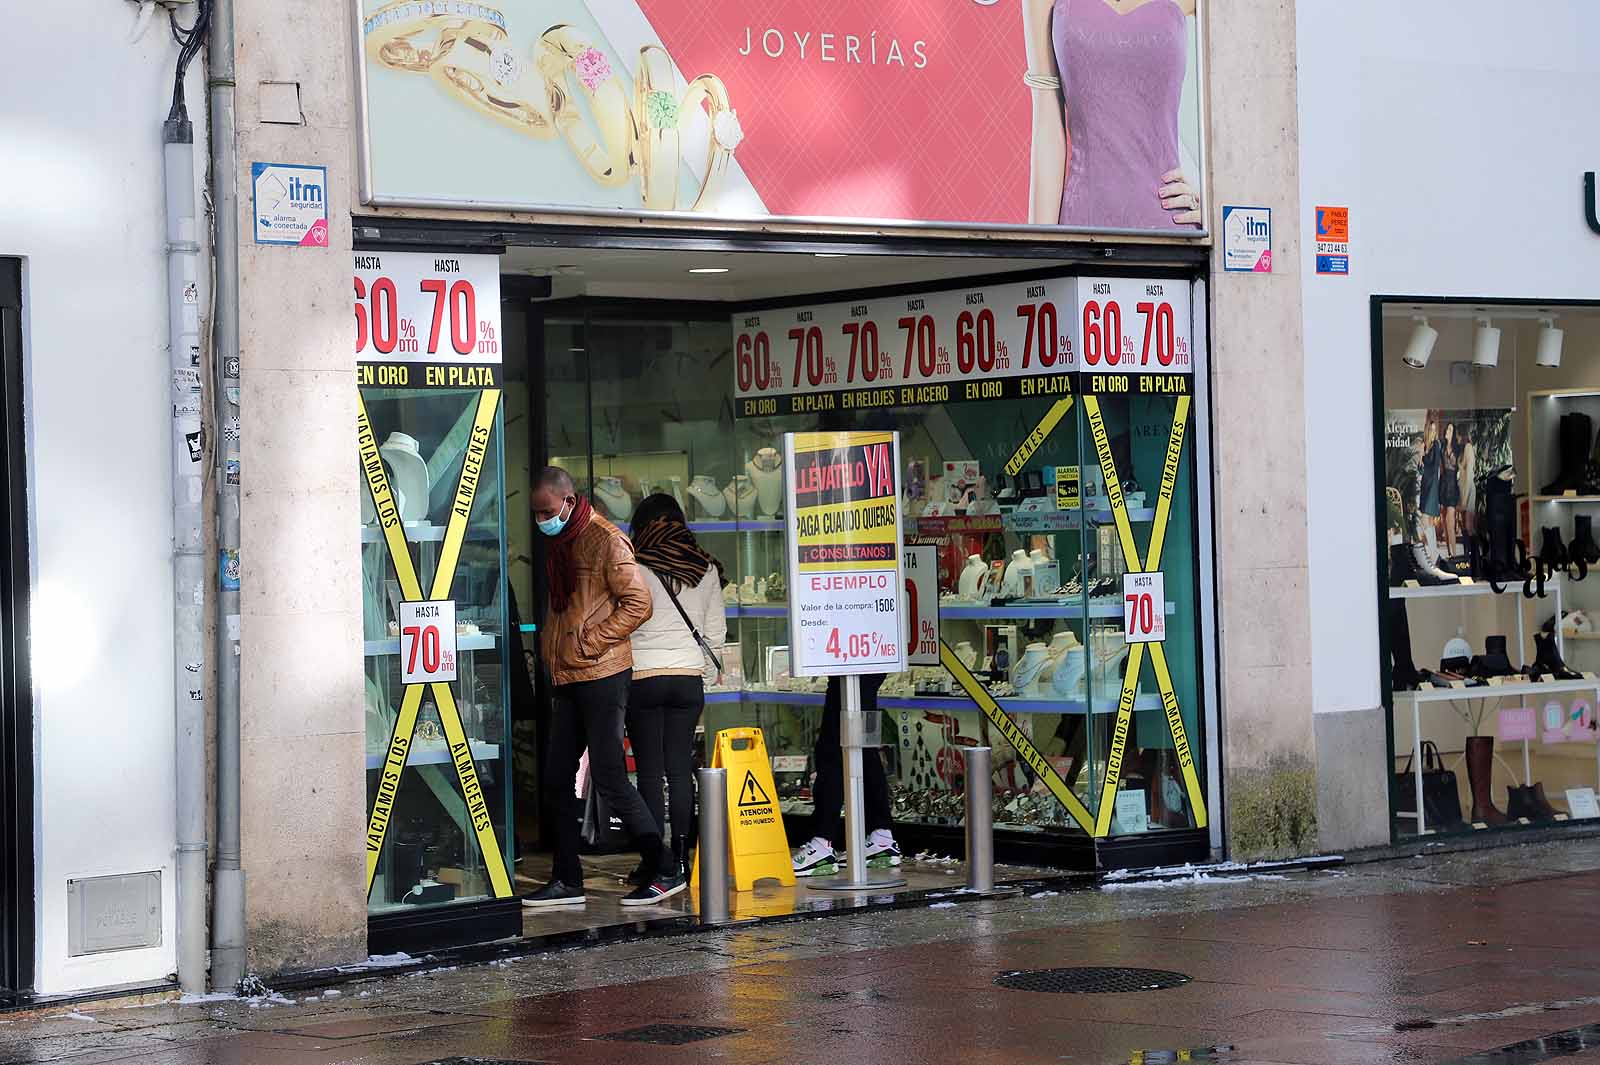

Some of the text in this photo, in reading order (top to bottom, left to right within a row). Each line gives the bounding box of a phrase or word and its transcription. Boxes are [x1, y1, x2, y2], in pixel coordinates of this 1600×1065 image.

[738, 27, 928, 69] JOYERÍAS
[289, 176, 322, 201] itm
[290, 202, 323, 210] seguridad
[273, 214, 297, 222] alarma
[1246, 216, 1268, 236] itm
[354, 256, 381, 270] HASTA
[434, 259, 460, 273] HASTA
[1026, 286, 1046, 298] HASTA
[1092, 283, 1111, 295] HASTA
[1146, 285, 1164, 296] HASTA
[907, 299, 925, 312] HASTA
[965, 292, 984, 305] HASTA
[797, 311, 813, 322] HASTA
[851, 305, 868, 317] HASTA
[744, 317, 760, 328] HASTA
[400, 338, 418, 353] DTO
[478, 340, 497, 354] DTO
[995, 357, 1010, 370] DTO
[1058, 352, 1074, 364] DTO
[1122, 353, 1136, 365] DTO
[1175, 353, 1188, 365] DTO
[357, 365, 409, 385] EN ORO
[425, 366, 494, 386] EN PLATA
[937, 363, 950, 375] DTO
[965, 381, 1003, 399] EN ORO
[1021, 375, 1071, 395] EN PLATA
[1092, 375, 1129, 393] EN ORO
[1140, 376, 1186, 393] EN PLATA
[842, 390, 895, 408] EN RELOJES
[901, 385, 949, 404] EN ACERO
[744, 399, 776, 415] EN ORO
[792, 394, 835, 412] EN PLATA
[1006, 427, 1044, 475] ACENES
[1090, 411, 1123, 509] VACIAMOS LOS
[1160, 420, 1184, 500] ALMACENES
[454, 425, 488, 518] ALMACENES
[864, 443, 893, 497] YA
[378, 498, 398, 529] LOS
[823, 508, 861, 534] CUANDO
[862, 503, 895, 530] QUIERAS
[811, 575, 887, 591] EJEMPLO
[1134, 576, 1153, 587] HASTA
[415, 606, 440, 619] HASTA
[801, 598, 895, 613] Valor de la compra: 150€
[920, 640, 937, 655] DTO
[441, 662, 454, 673] DTO
[1106, 687, 1134, 785] VACIAMOS LOS
[1163, 691, 1192, 768] ALMACENES
[990, 707, 1049, 778] ALMACENES
[366, 736, 408, 852] VACIAMOS LOS
[451, 742, 490, 832] ALMACENES
[739, 808, 773, 817] ATENCION
[753, 817, 775, 825] HUMEDO
